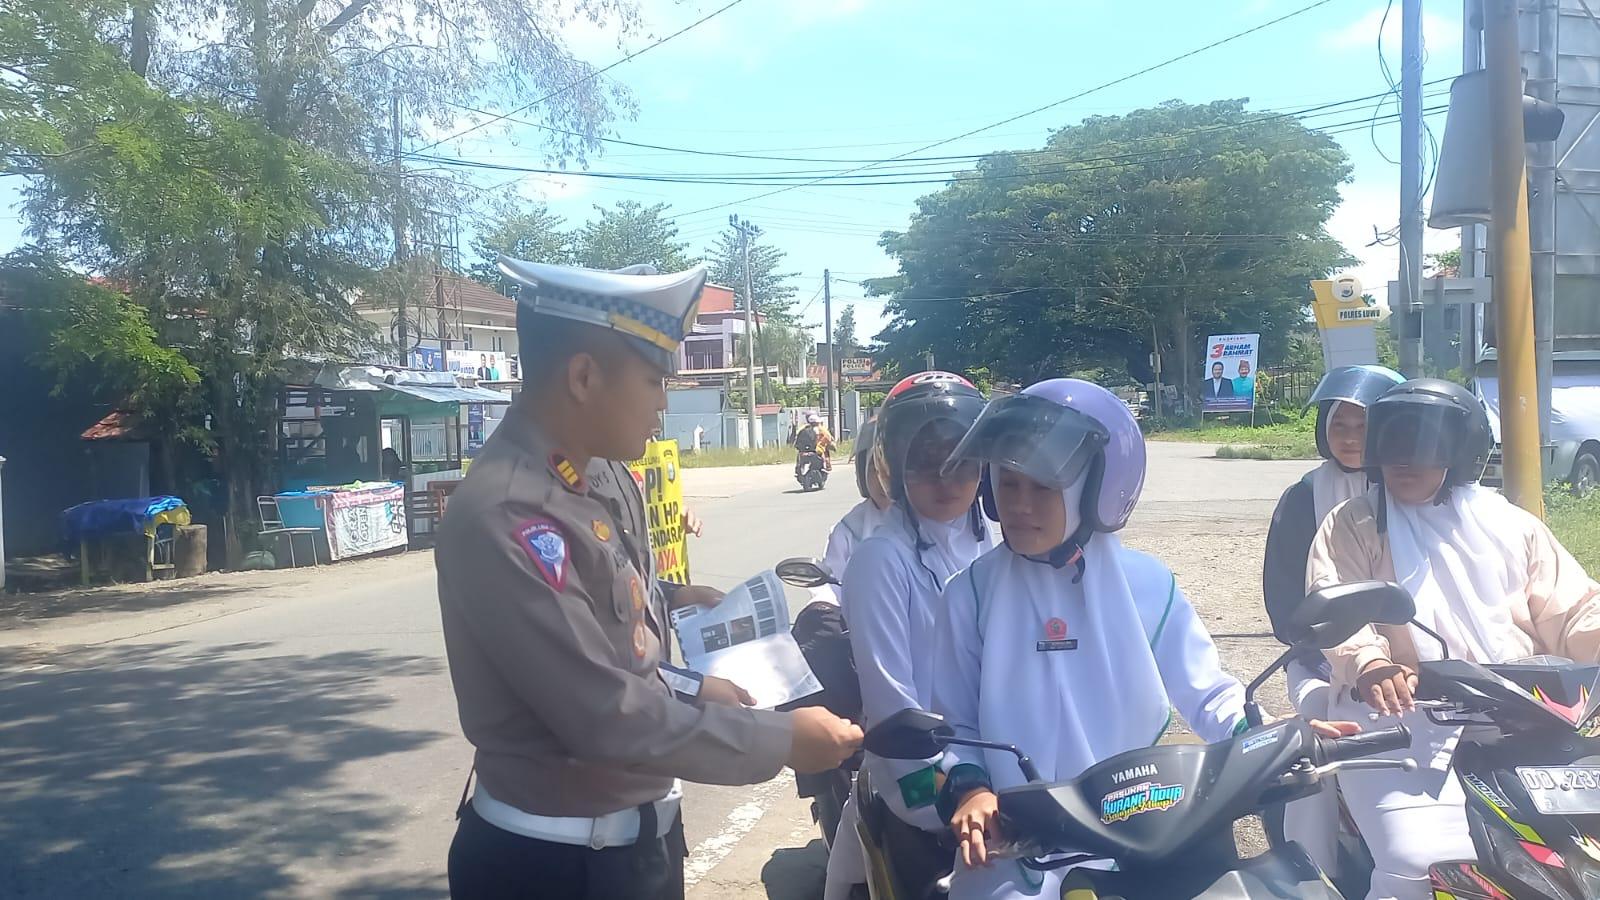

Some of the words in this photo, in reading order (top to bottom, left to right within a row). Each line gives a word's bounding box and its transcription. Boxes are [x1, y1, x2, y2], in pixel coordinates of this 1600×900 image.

[1210, 343, 1224, 358] 3
[644, 467, 663, 503] P!
[648, 504, 660, 529] N
[663, 501, 679, 525] HP
[656, 547, 678, 572] AYA
[1112, 764, 1158, 783] YAMAHA
